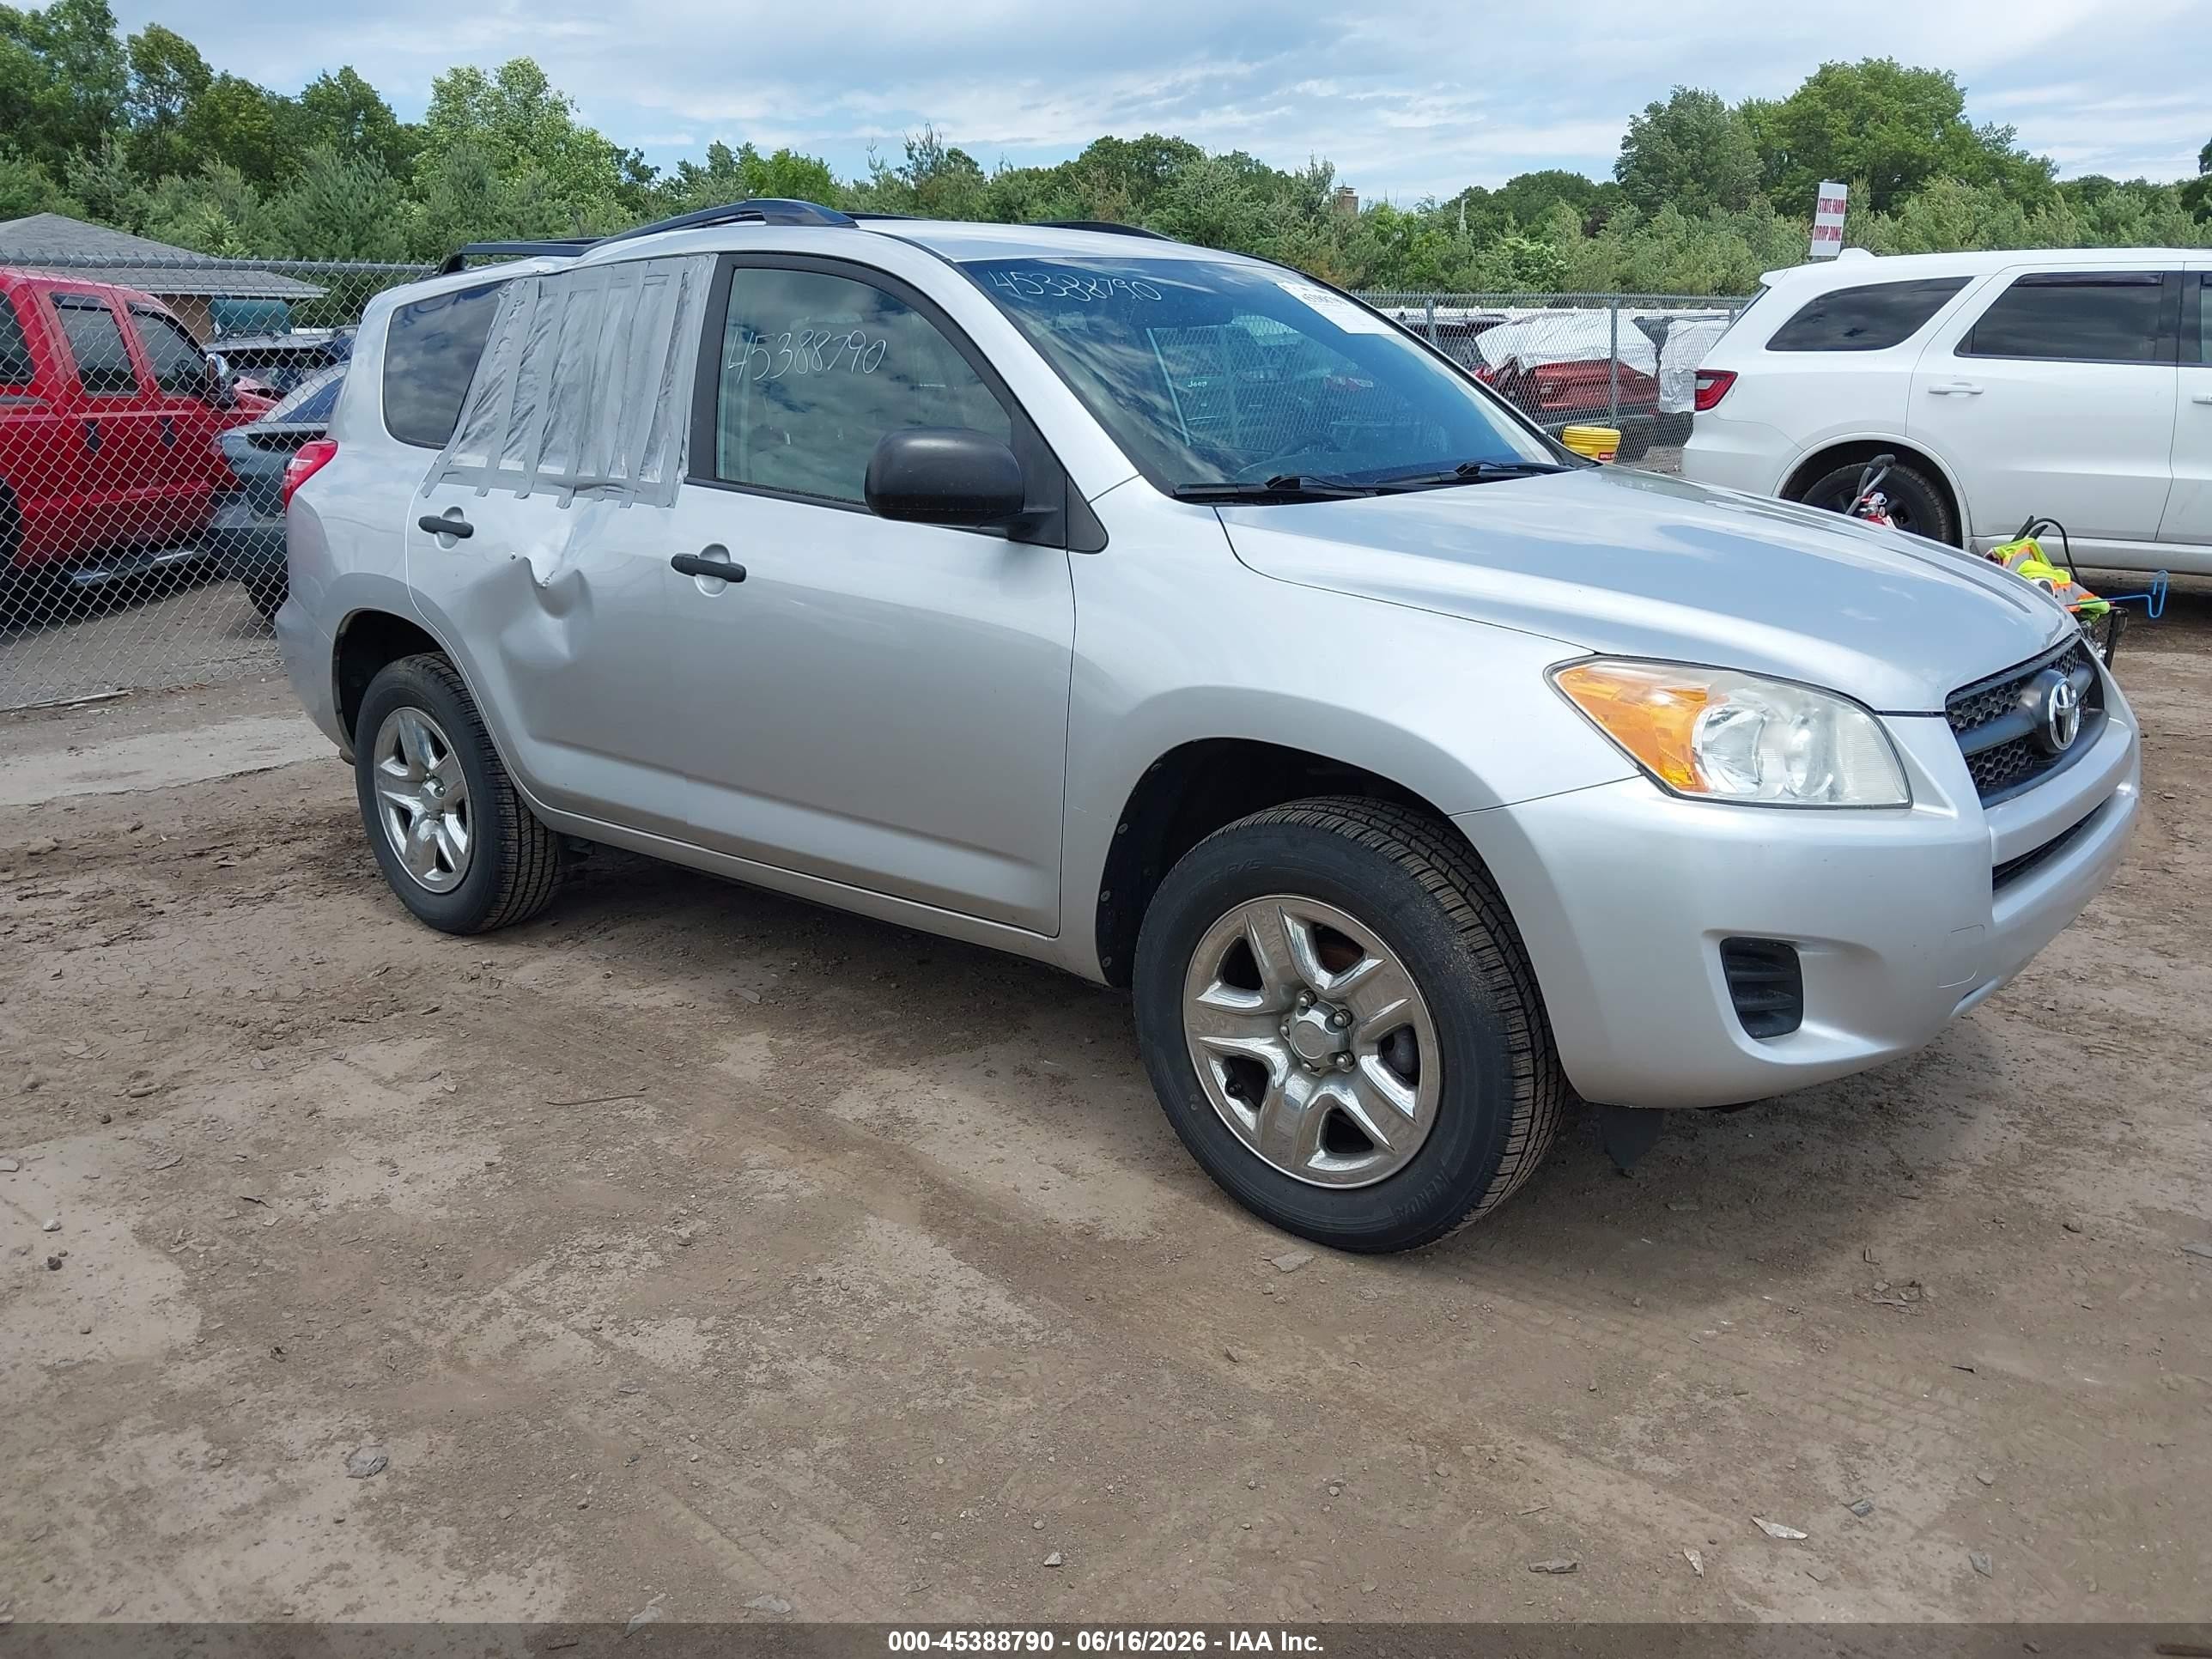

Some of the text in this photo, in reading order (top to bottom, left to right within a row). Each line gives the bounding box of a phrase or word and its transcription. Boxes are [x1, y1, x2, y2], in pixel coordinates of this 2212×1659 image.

[1819, 198, 1845, 215] STATE FARM
[1814, 225, 1842, 241] DROP ZONE
[988, 270, 1163, 302] 45388790
[727, 329, 887, 385] 45388790
